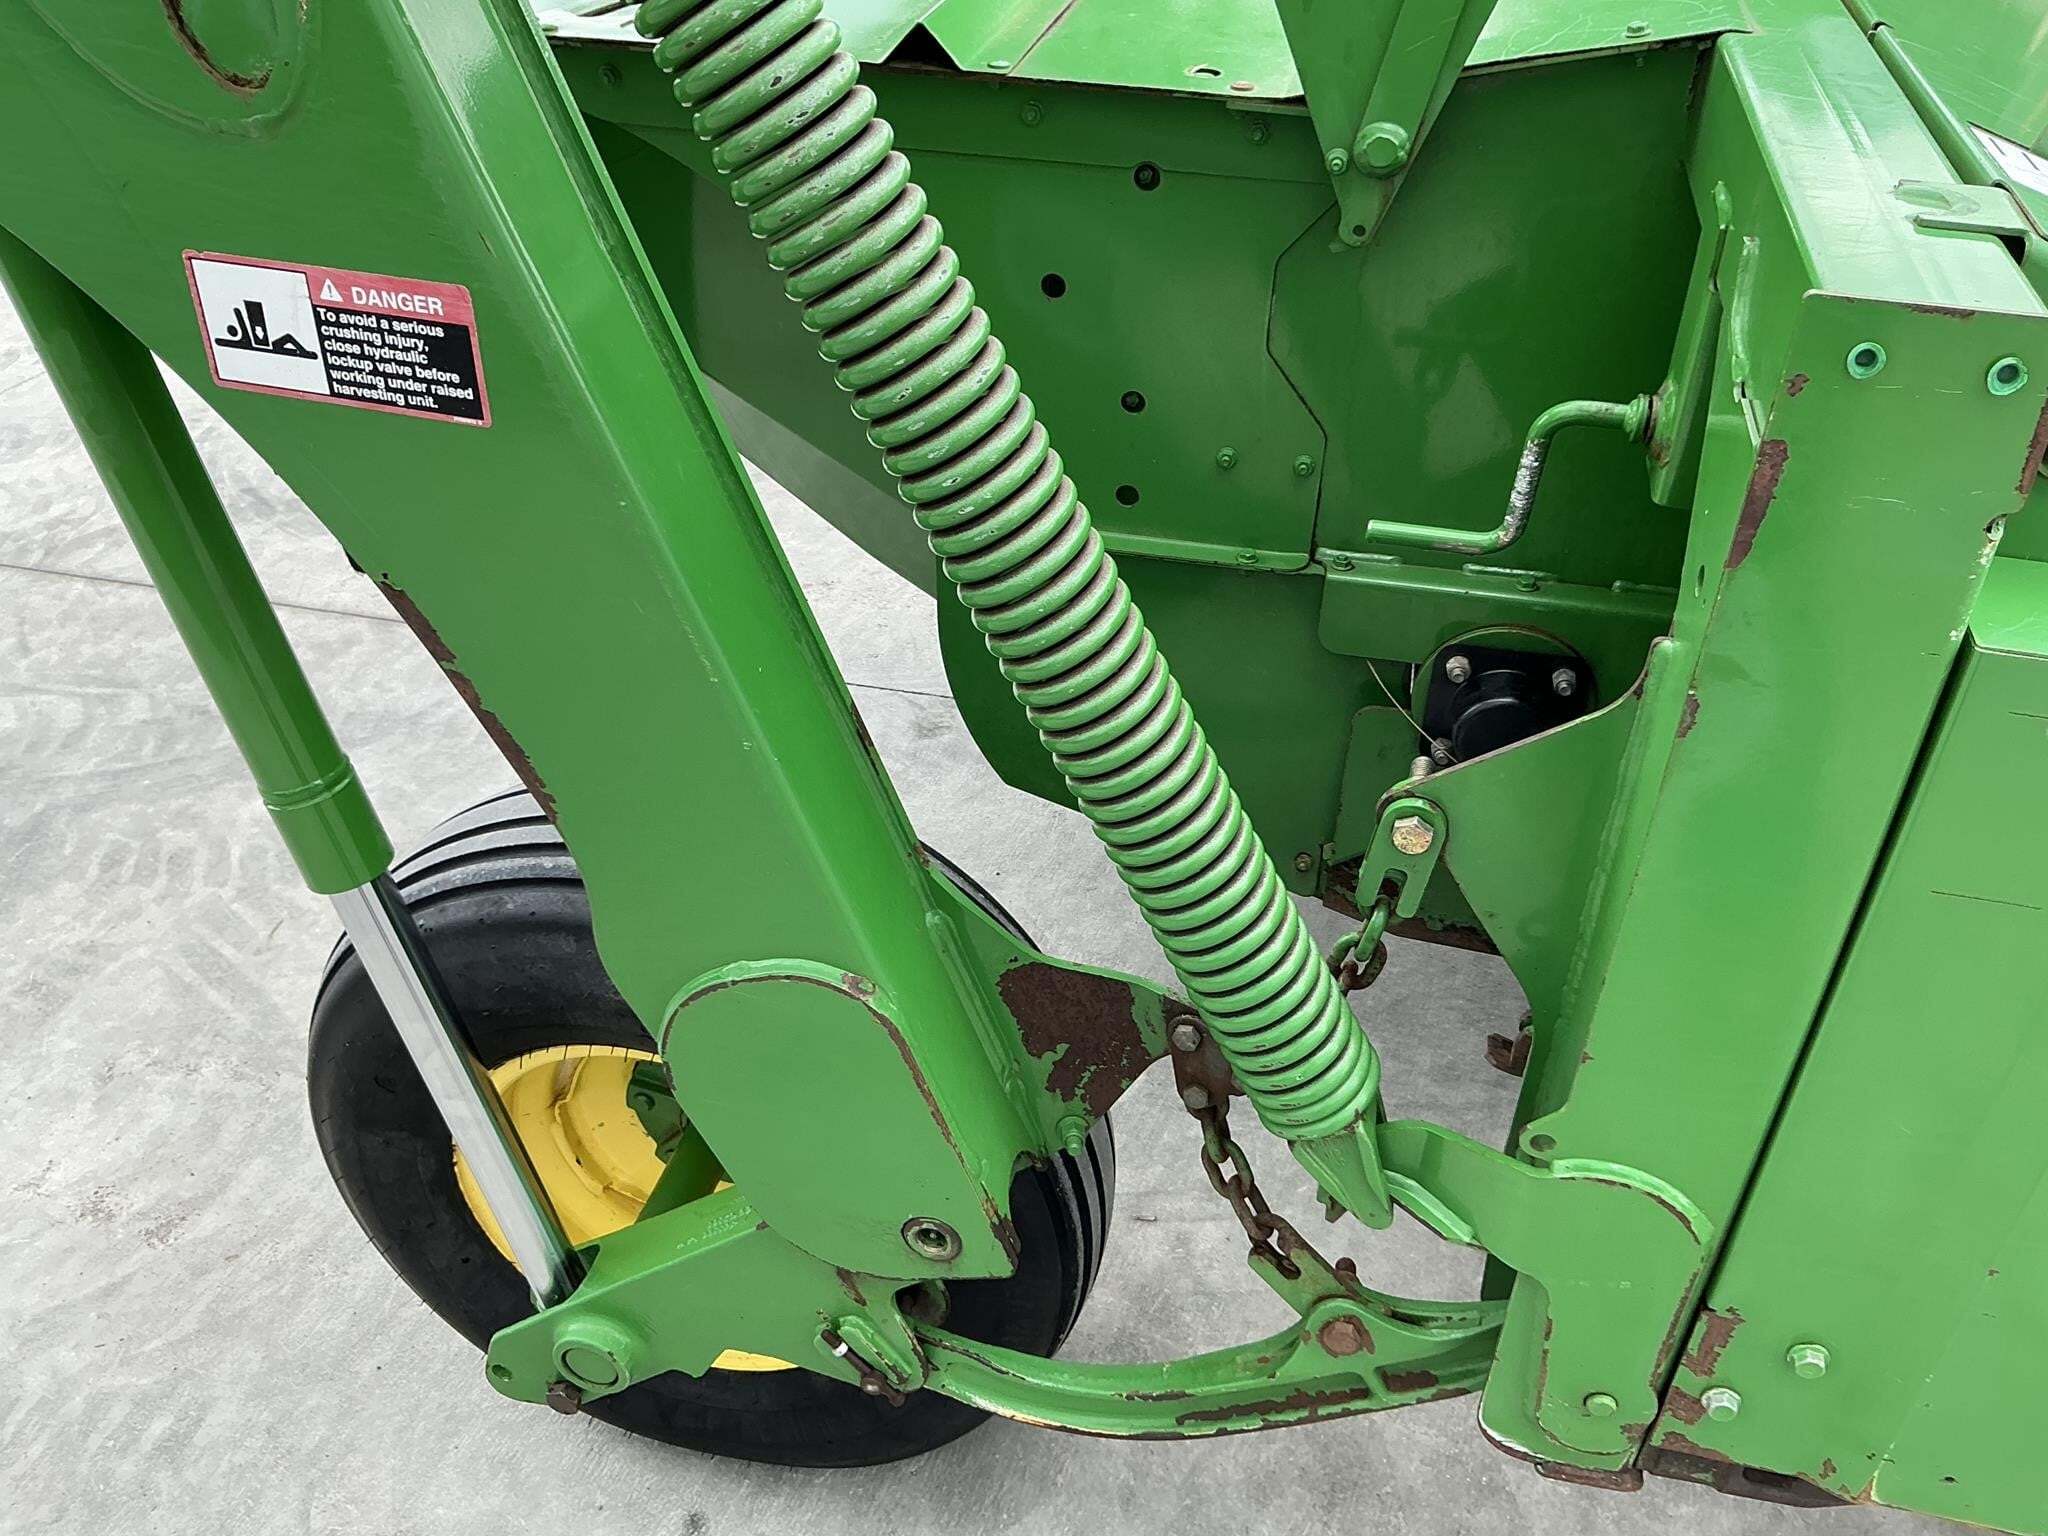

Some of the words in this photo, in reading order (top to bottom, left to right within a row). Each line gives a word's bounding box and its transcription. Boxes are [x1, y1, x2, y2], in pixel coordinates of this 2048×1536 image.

[352, 286, 444, 315] DANGER
[317, 309, 335, 322] To
[339, 313, 377, 328] avoid
[380, 319, 389, 330] a
[392, 321, 444, 337] serious
[321, 325, 382, 347] crushing
[385, 332, 428, 351] injury,
[324, 339, 361, 354] close
[363, 343, 428, 365] hydraulic
[327, 353, 373, 372] lockup
[376, 361, 412, 377] valve
[415, 366, 460, 383] before
[330, 370, 384, 388] working
[388, 377, 428, 392] under
[430, 383, 473, 400] raised
[333, 382, 406, 406] harvesting
[408, 394, 438, 408] unit.
